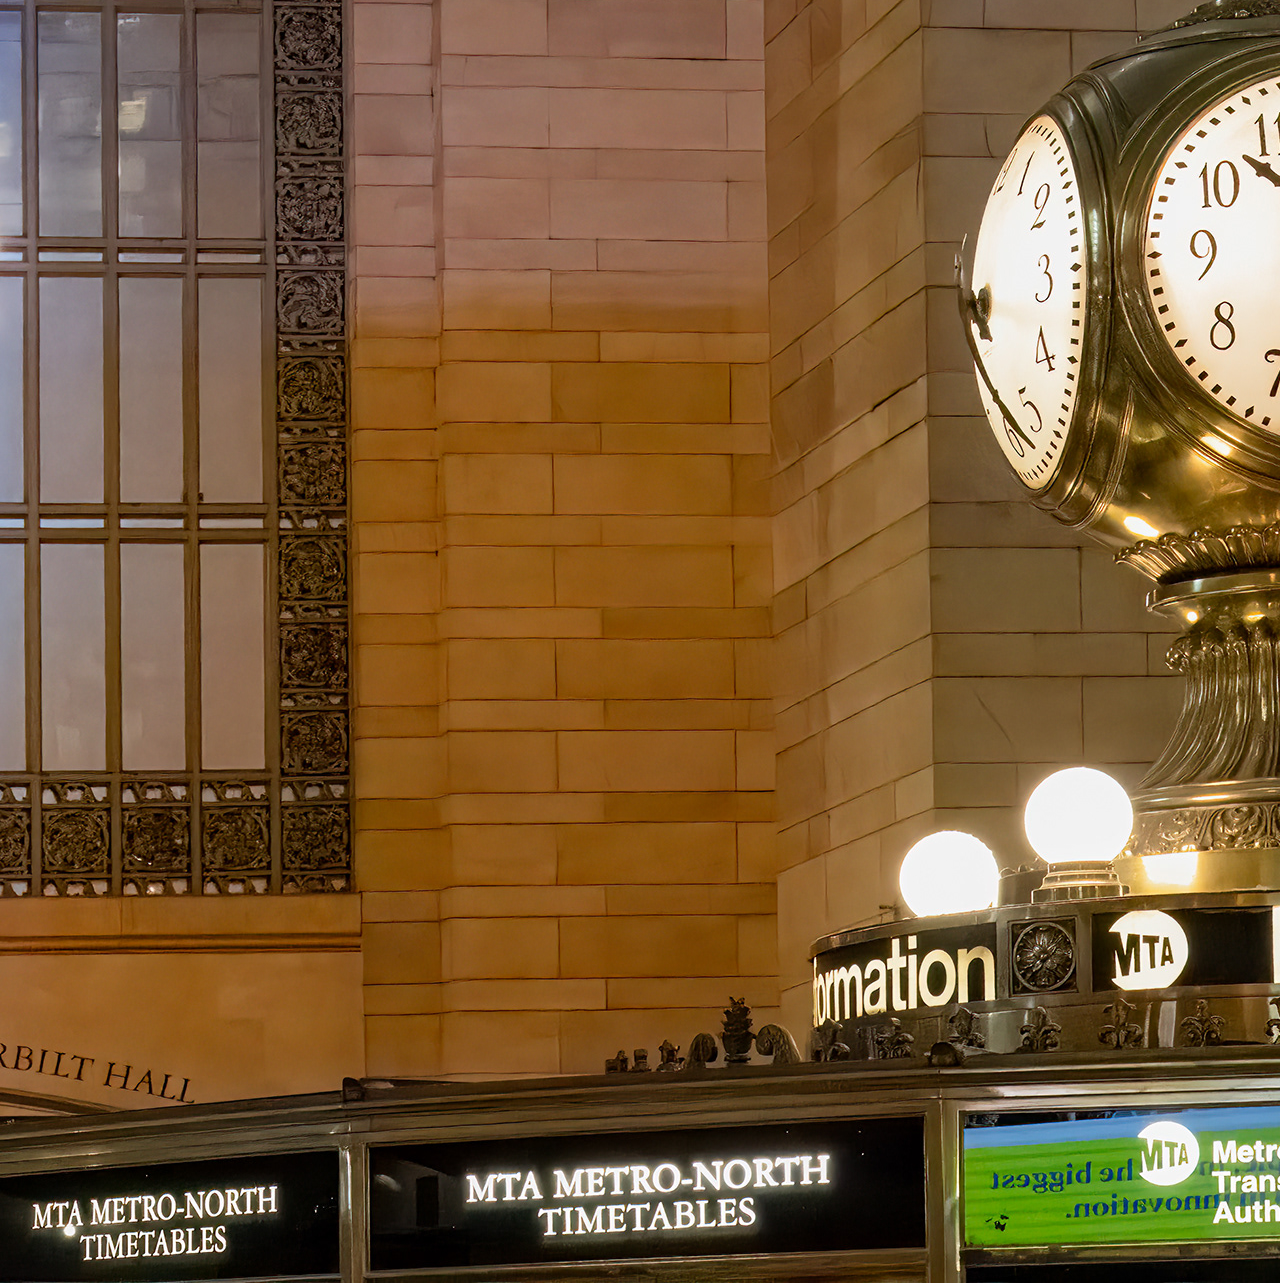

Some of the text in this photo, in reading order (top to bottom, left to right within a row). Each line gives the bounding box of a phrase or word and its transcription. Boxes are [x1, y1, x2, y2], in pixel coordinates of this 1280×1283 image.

[1017, 151, 1035, 196] 1
[1199, 160, 1240, 209] 10
[1030, 183, 1049, 231] 2
[1190, 229, 1217, 281] 9
[1035, 254, 1053, 304] 3
[1035, 325, 1055, 373] 4
[1210, 301, 1235, 350] 8
[1018, 386, 1043, 433] 5
[1003, 415, 1025, 458] 6
[1111, 930, 1179, 982] MTA
[102, 1060, 197, 1105] HALL
[1138, 1134, 1191, 1175] MTA
[465, 1153, 832, 1204] MTA METRO-NORTH
[32, 1185, 279, 1231] MTA METRO-NORTH
[537, 1196, 757, 1237] TIMETABLES
[79, 1224, 228, 1262] TIMETABLES
